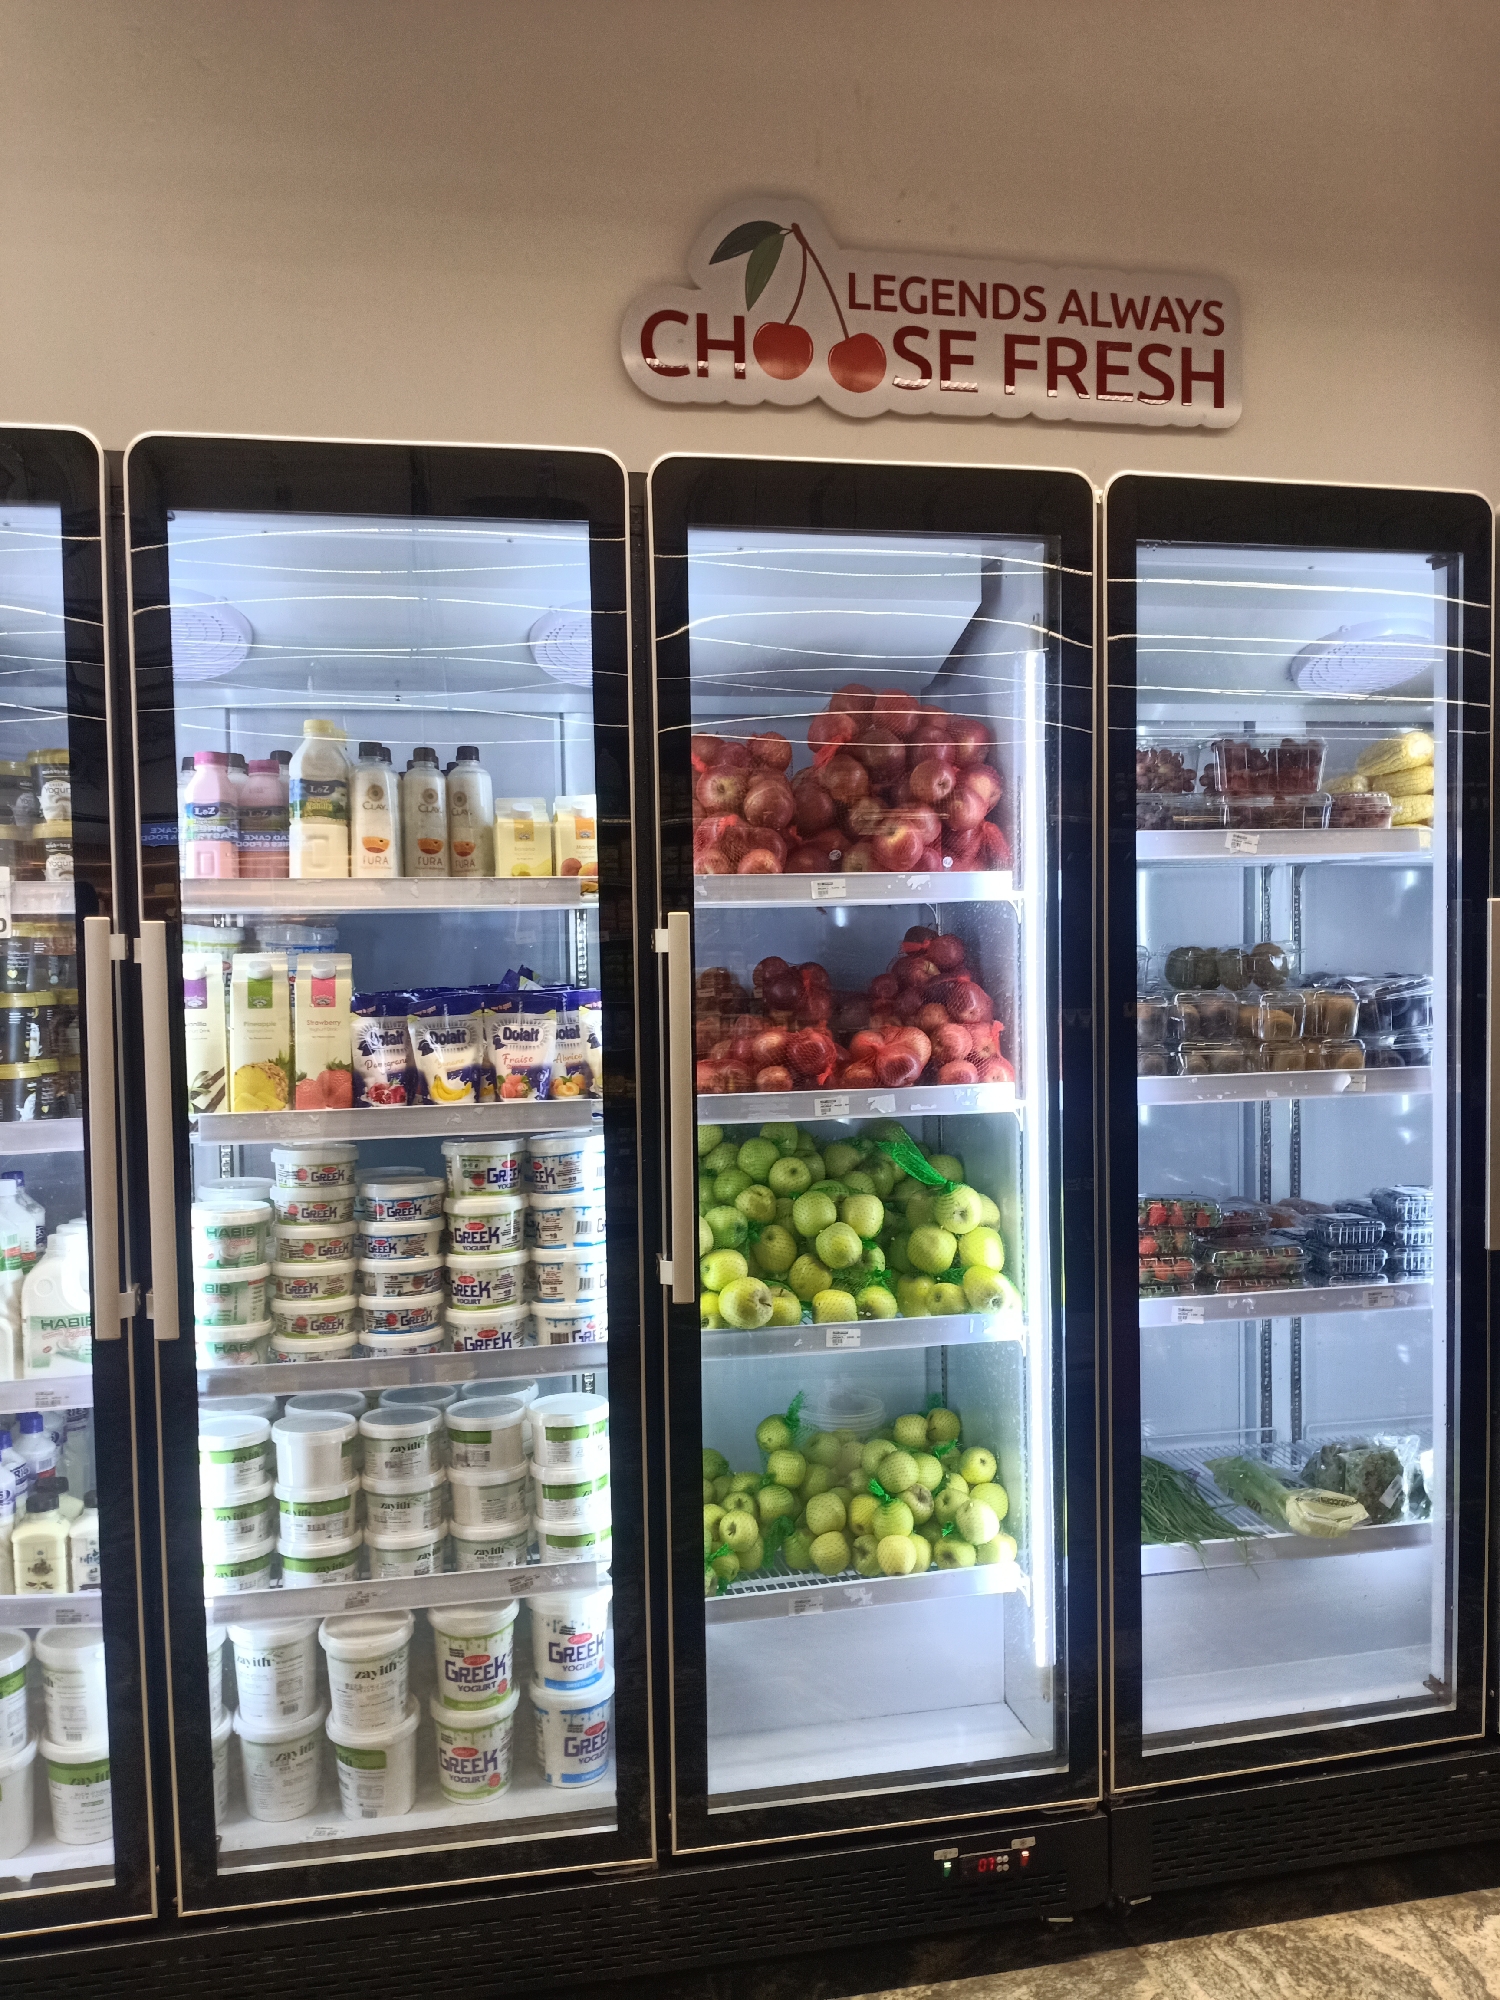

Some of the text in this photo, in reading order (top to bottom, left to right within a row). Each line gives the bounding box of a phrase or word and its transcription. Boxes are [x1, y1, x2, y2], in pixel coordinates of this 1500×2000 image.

[847, 272, 1226, 337] LEGENDS ALWAYS
[1003, 333, 1226, 409] FRESH
[306, 1019, 342, 1027] Strawberry
[502, 1053, 534, 1065] Fraise
[311, 1169, 345, 1183] GREEK
[301, 1207, 337, 1219] GREEK
[387, 1203, 422, 1218] GREEK
[206, 1226, 255, 1239] HABIB
[453, 1226, 501, 1245] GREEK
[318, 1243, 349, 1256] GREEK
[285, 1282, 318, 1295] GREEK
[452, 1280, 491, 1299] GREEK
[311, 1319, 345, 1331] GREEK
[390, 1441, 421, 1455] zayith
[380, 1501, 411, 1512] zayith
[474, 1546, 505, 1557] zayith
[548, 1634, 605, 1664] GREEK
[355, 1660, 398, 1681] zayith
[445, 1653, 507, 1683] GREEK
[562, 1658, 597, 1672] YOGURT
[457, 1680, 497, 1693] YOGURT
[439, 1748, 499, 1775] GREEK
[449, 1774, 486, 1784] YOGURT
